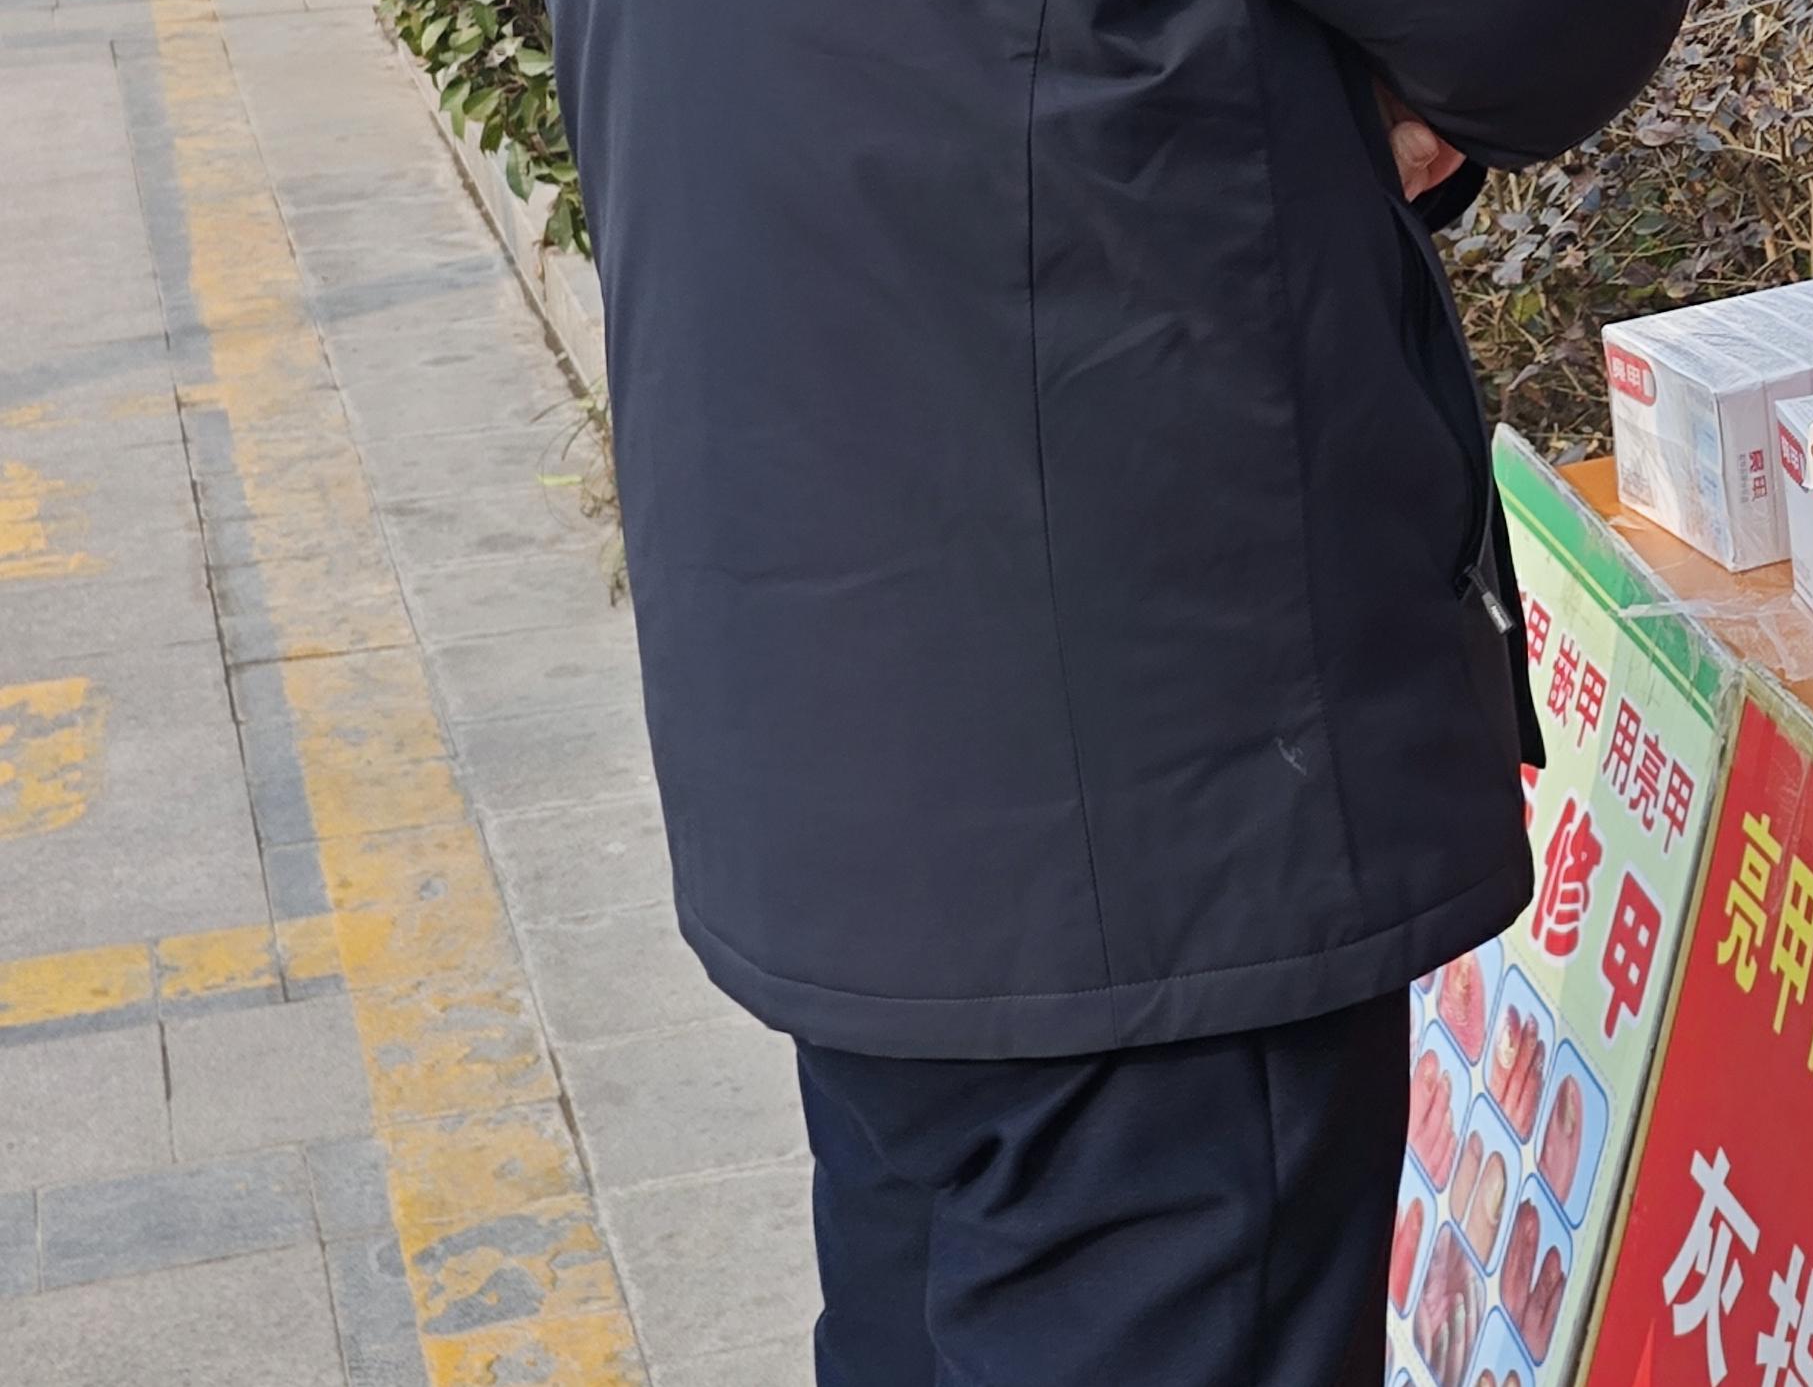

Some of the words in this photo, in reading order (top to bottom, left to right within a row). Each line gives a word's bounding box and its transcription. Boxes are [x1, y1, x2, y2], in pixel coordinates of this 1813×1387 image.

[1519, 590, 1552, 667] 甲
[1602, 697, 1695, 854] 用亮甲
[1520, 762, 1662, 1040] 修甲
